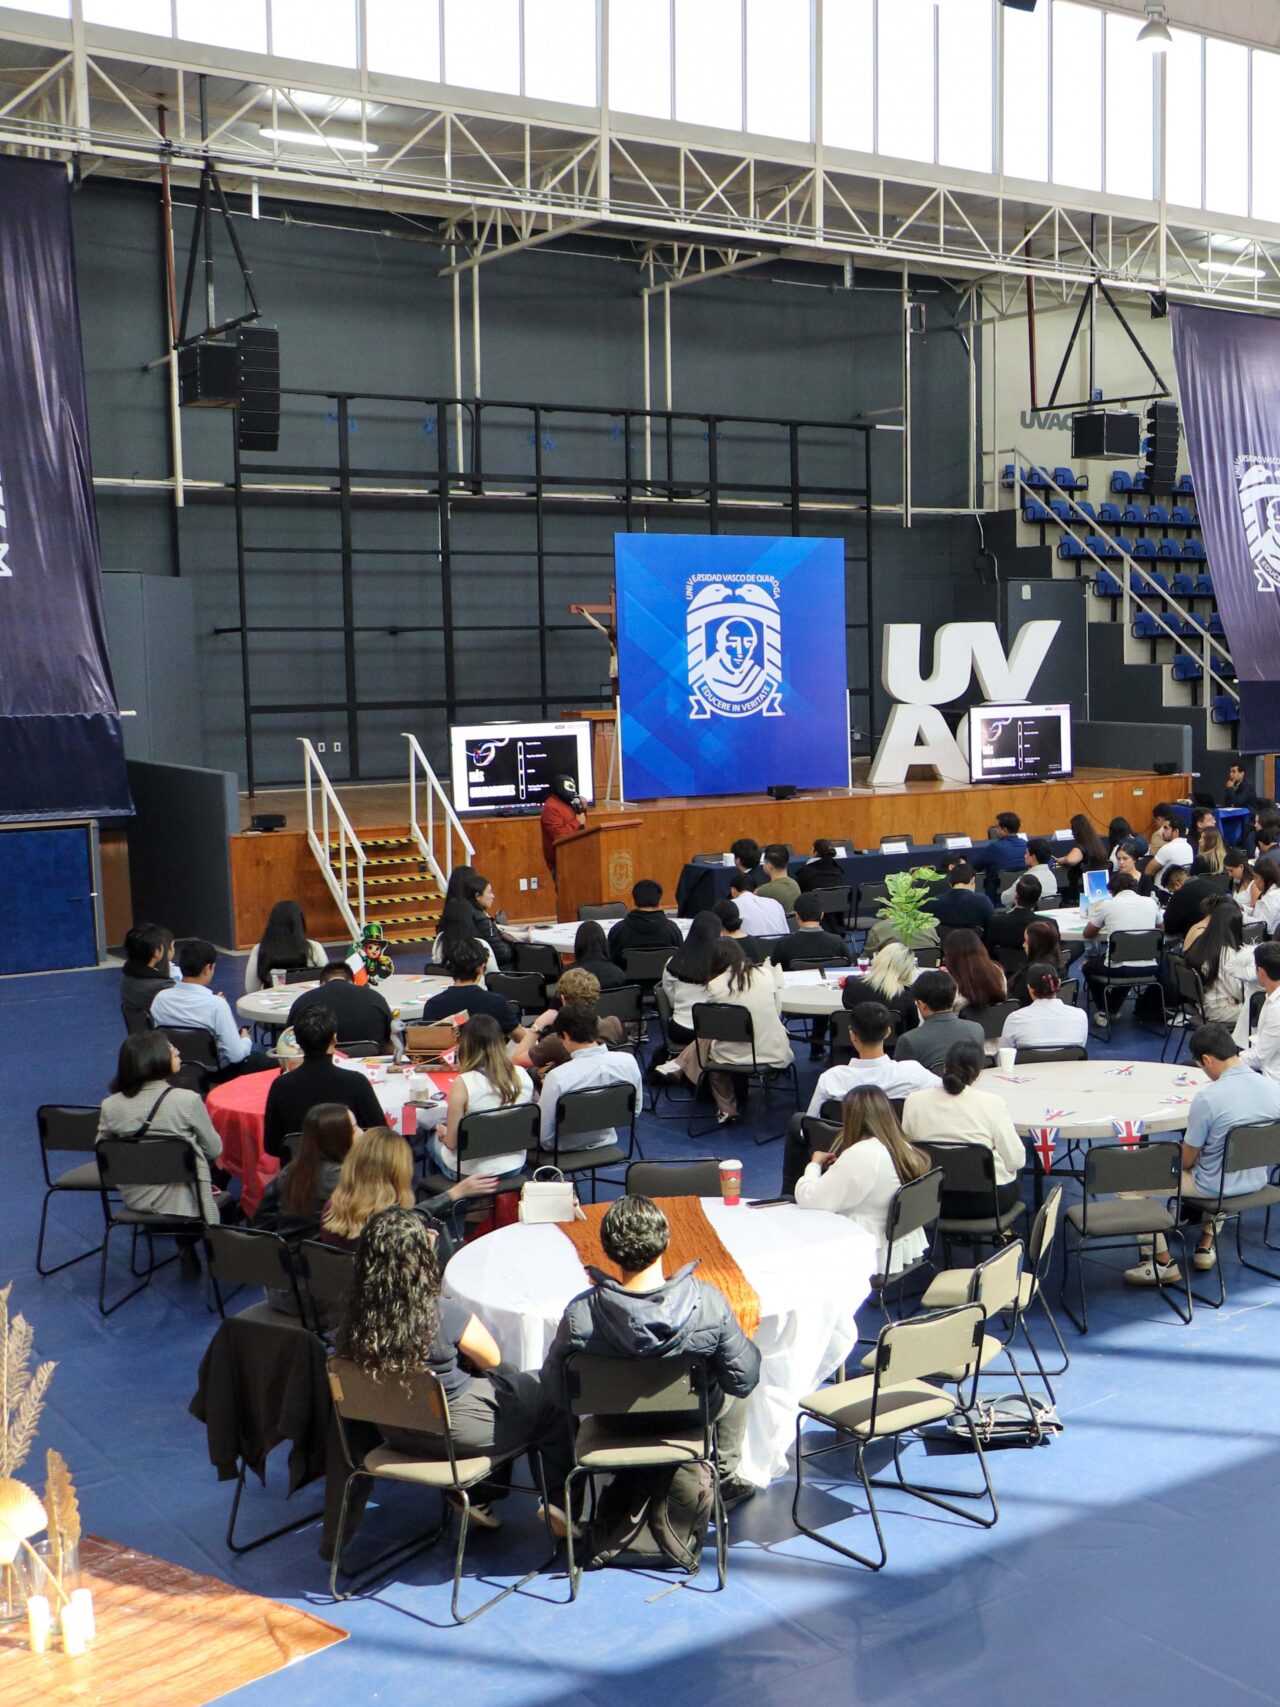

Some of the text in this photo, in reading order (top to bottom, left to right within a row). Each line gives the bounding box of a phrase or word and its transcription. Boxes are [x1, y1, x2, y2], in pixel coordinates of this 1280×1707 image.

[686, 573, 781, 600] UNIVERSIDAD VASCO DE QUIROGA
[882, 620, 1061, 705] UV
[701, 685, 770, 712] EDUCERE IN VERITATE
